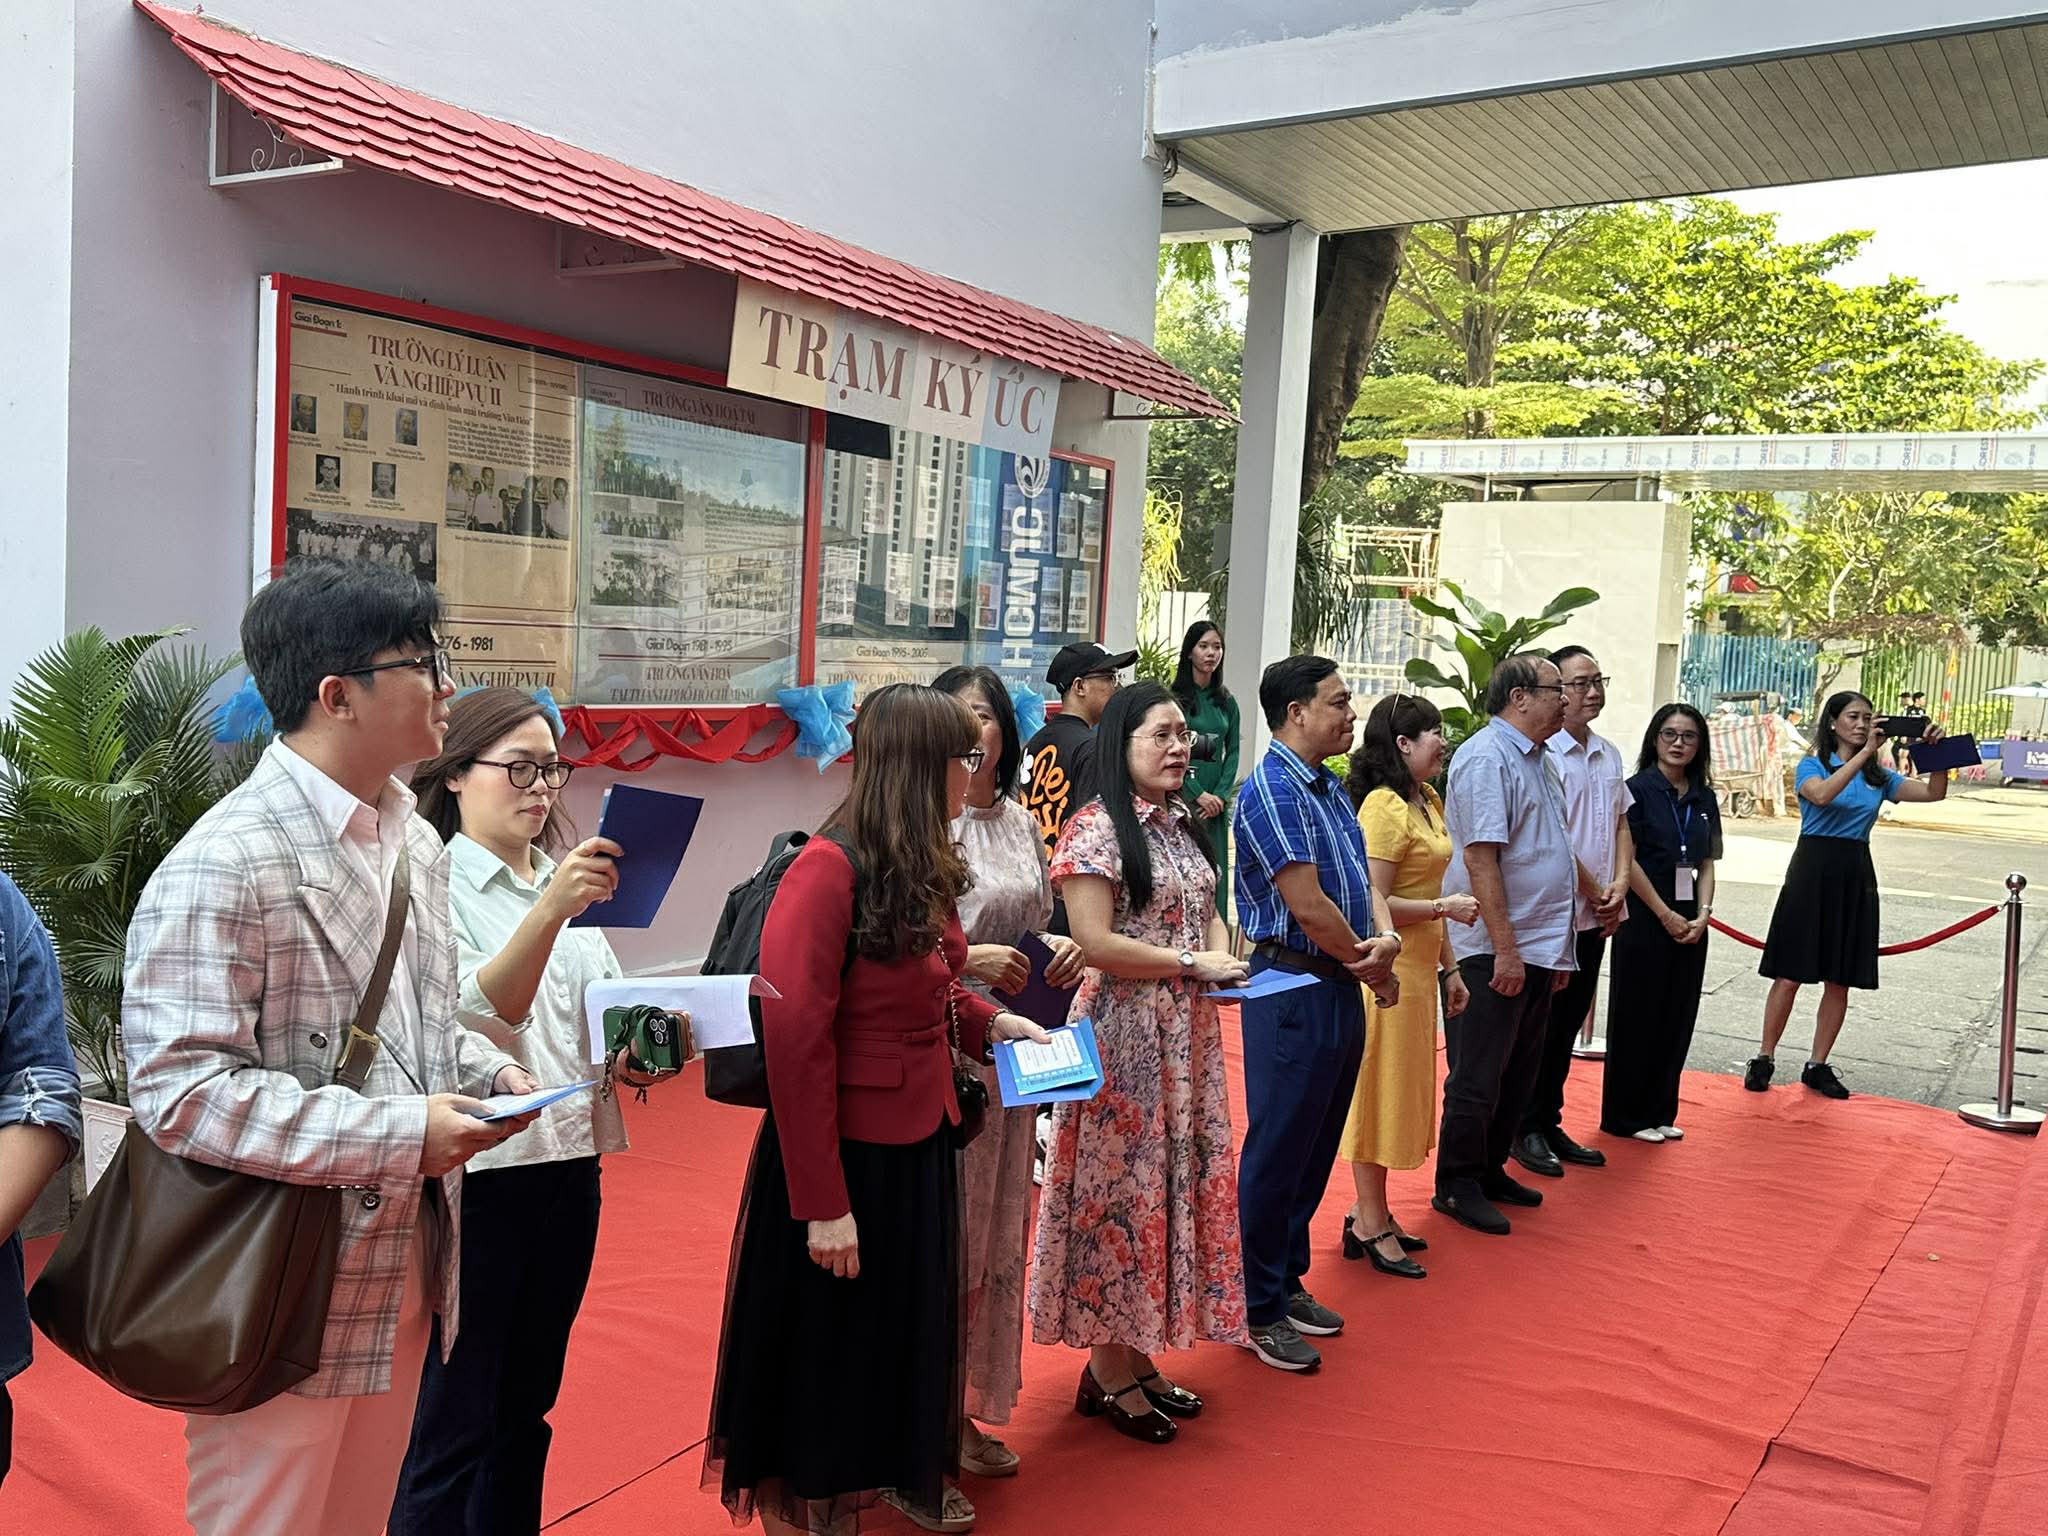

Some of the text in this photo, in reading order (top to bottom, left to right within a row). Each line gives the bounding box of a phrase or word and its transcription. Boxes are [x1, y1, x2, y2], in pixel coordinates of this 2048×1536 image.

[295, 311, 312, 322] Giai
[367, 334, 507, 383] TRƯỜNG LÝ LUẬN
[759, 306, 1047, 435] TRẠM KÝ ỨC
[374, 360, 502, 408] VÀ NGHIỆP VỤ II
[471, 636, 494, 651] 1981
[646, 637, 665, 650] Giai
